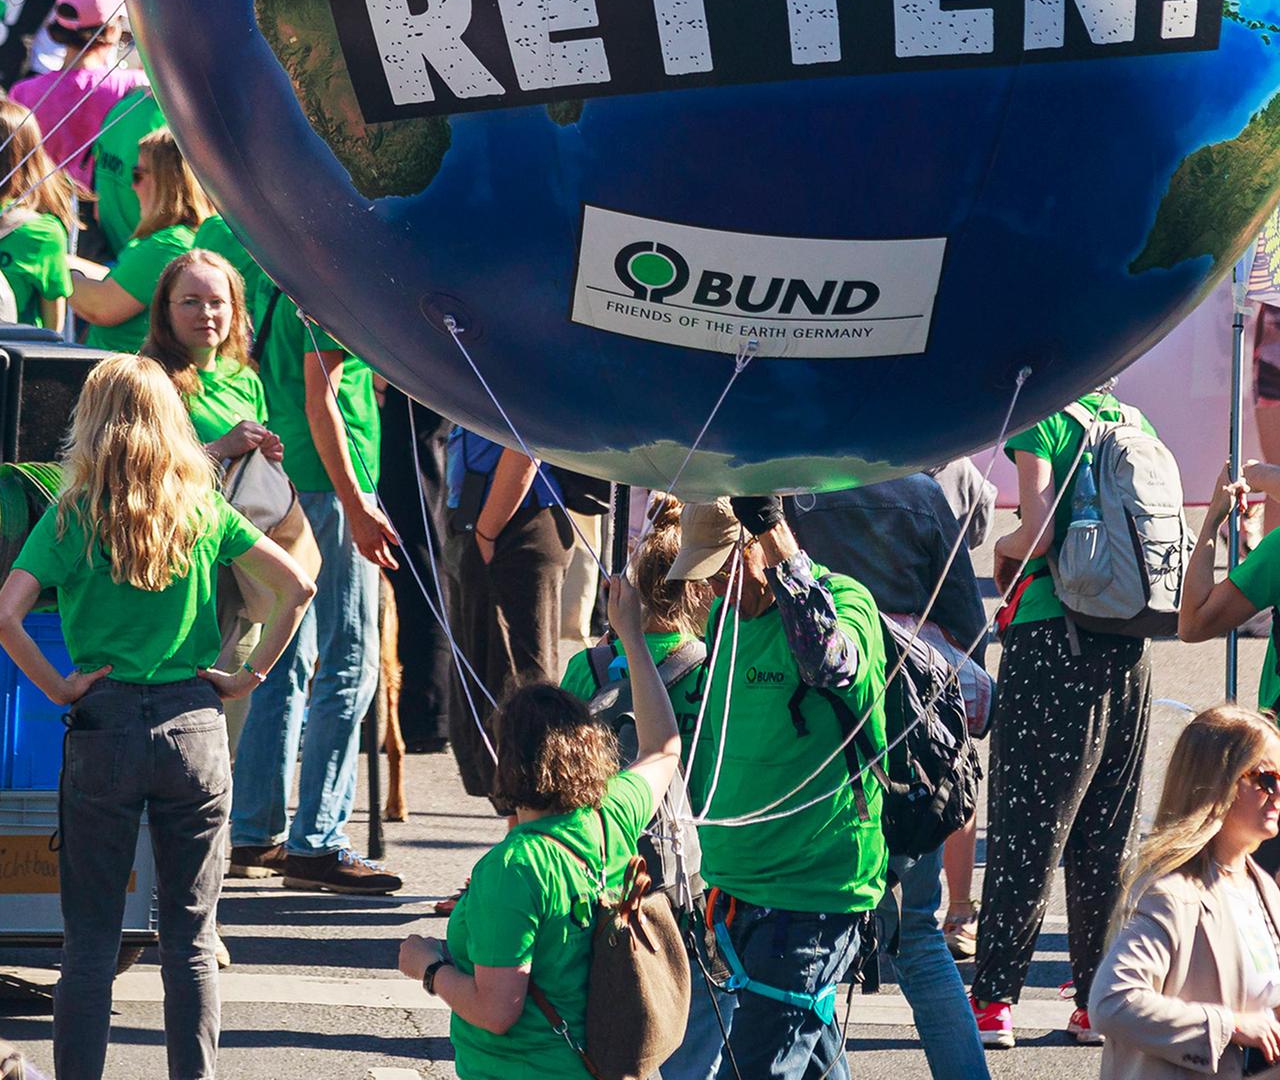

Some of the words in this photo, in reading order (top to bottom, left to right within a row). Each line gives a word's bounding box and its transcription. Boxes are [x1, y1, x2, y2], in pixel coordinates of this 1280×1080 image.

[691, 269, 881, 316] BUND
[606, 300, 673, 324] FRIENDS
[679, 314, 701, 329] OF
[705, 319, 734, 335] THE
[739, 325, 787, 339] EARTH
[792, 326, 875, 340] GERMANY
[757, 670, 785, 682] BUND
